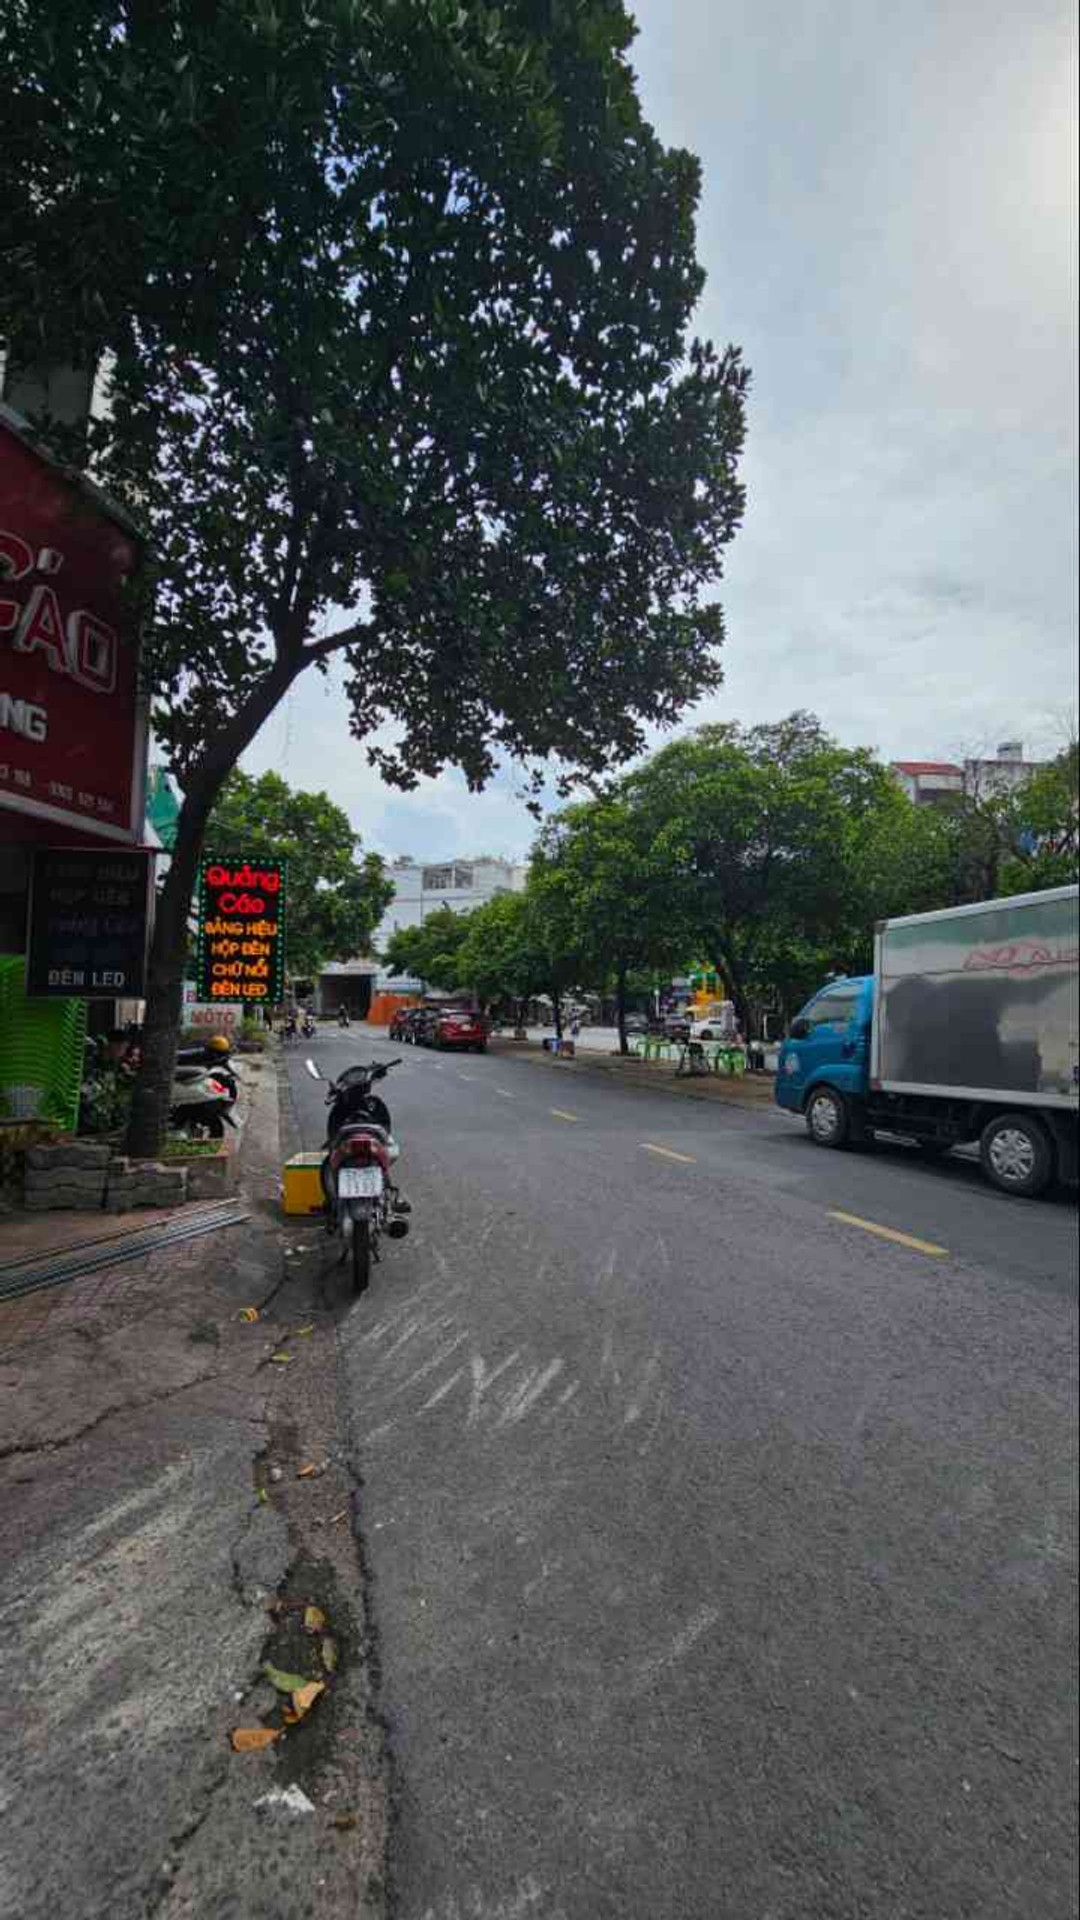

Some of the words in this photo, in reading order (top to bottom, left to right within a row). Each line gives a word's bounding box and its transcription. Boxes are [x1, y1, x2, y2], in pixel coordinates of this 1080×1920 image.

[206, 864, 280, 891] Quảng
[218, 892, 265, 913] Cáo
[205, 917, 244, 934] BẢNG
[246, 920, 277, 938] HIỆU
[212, 939, 239, 957] HỘP
[92, 971, 126, 987] LED
[242, 983, 267, 996] LED
